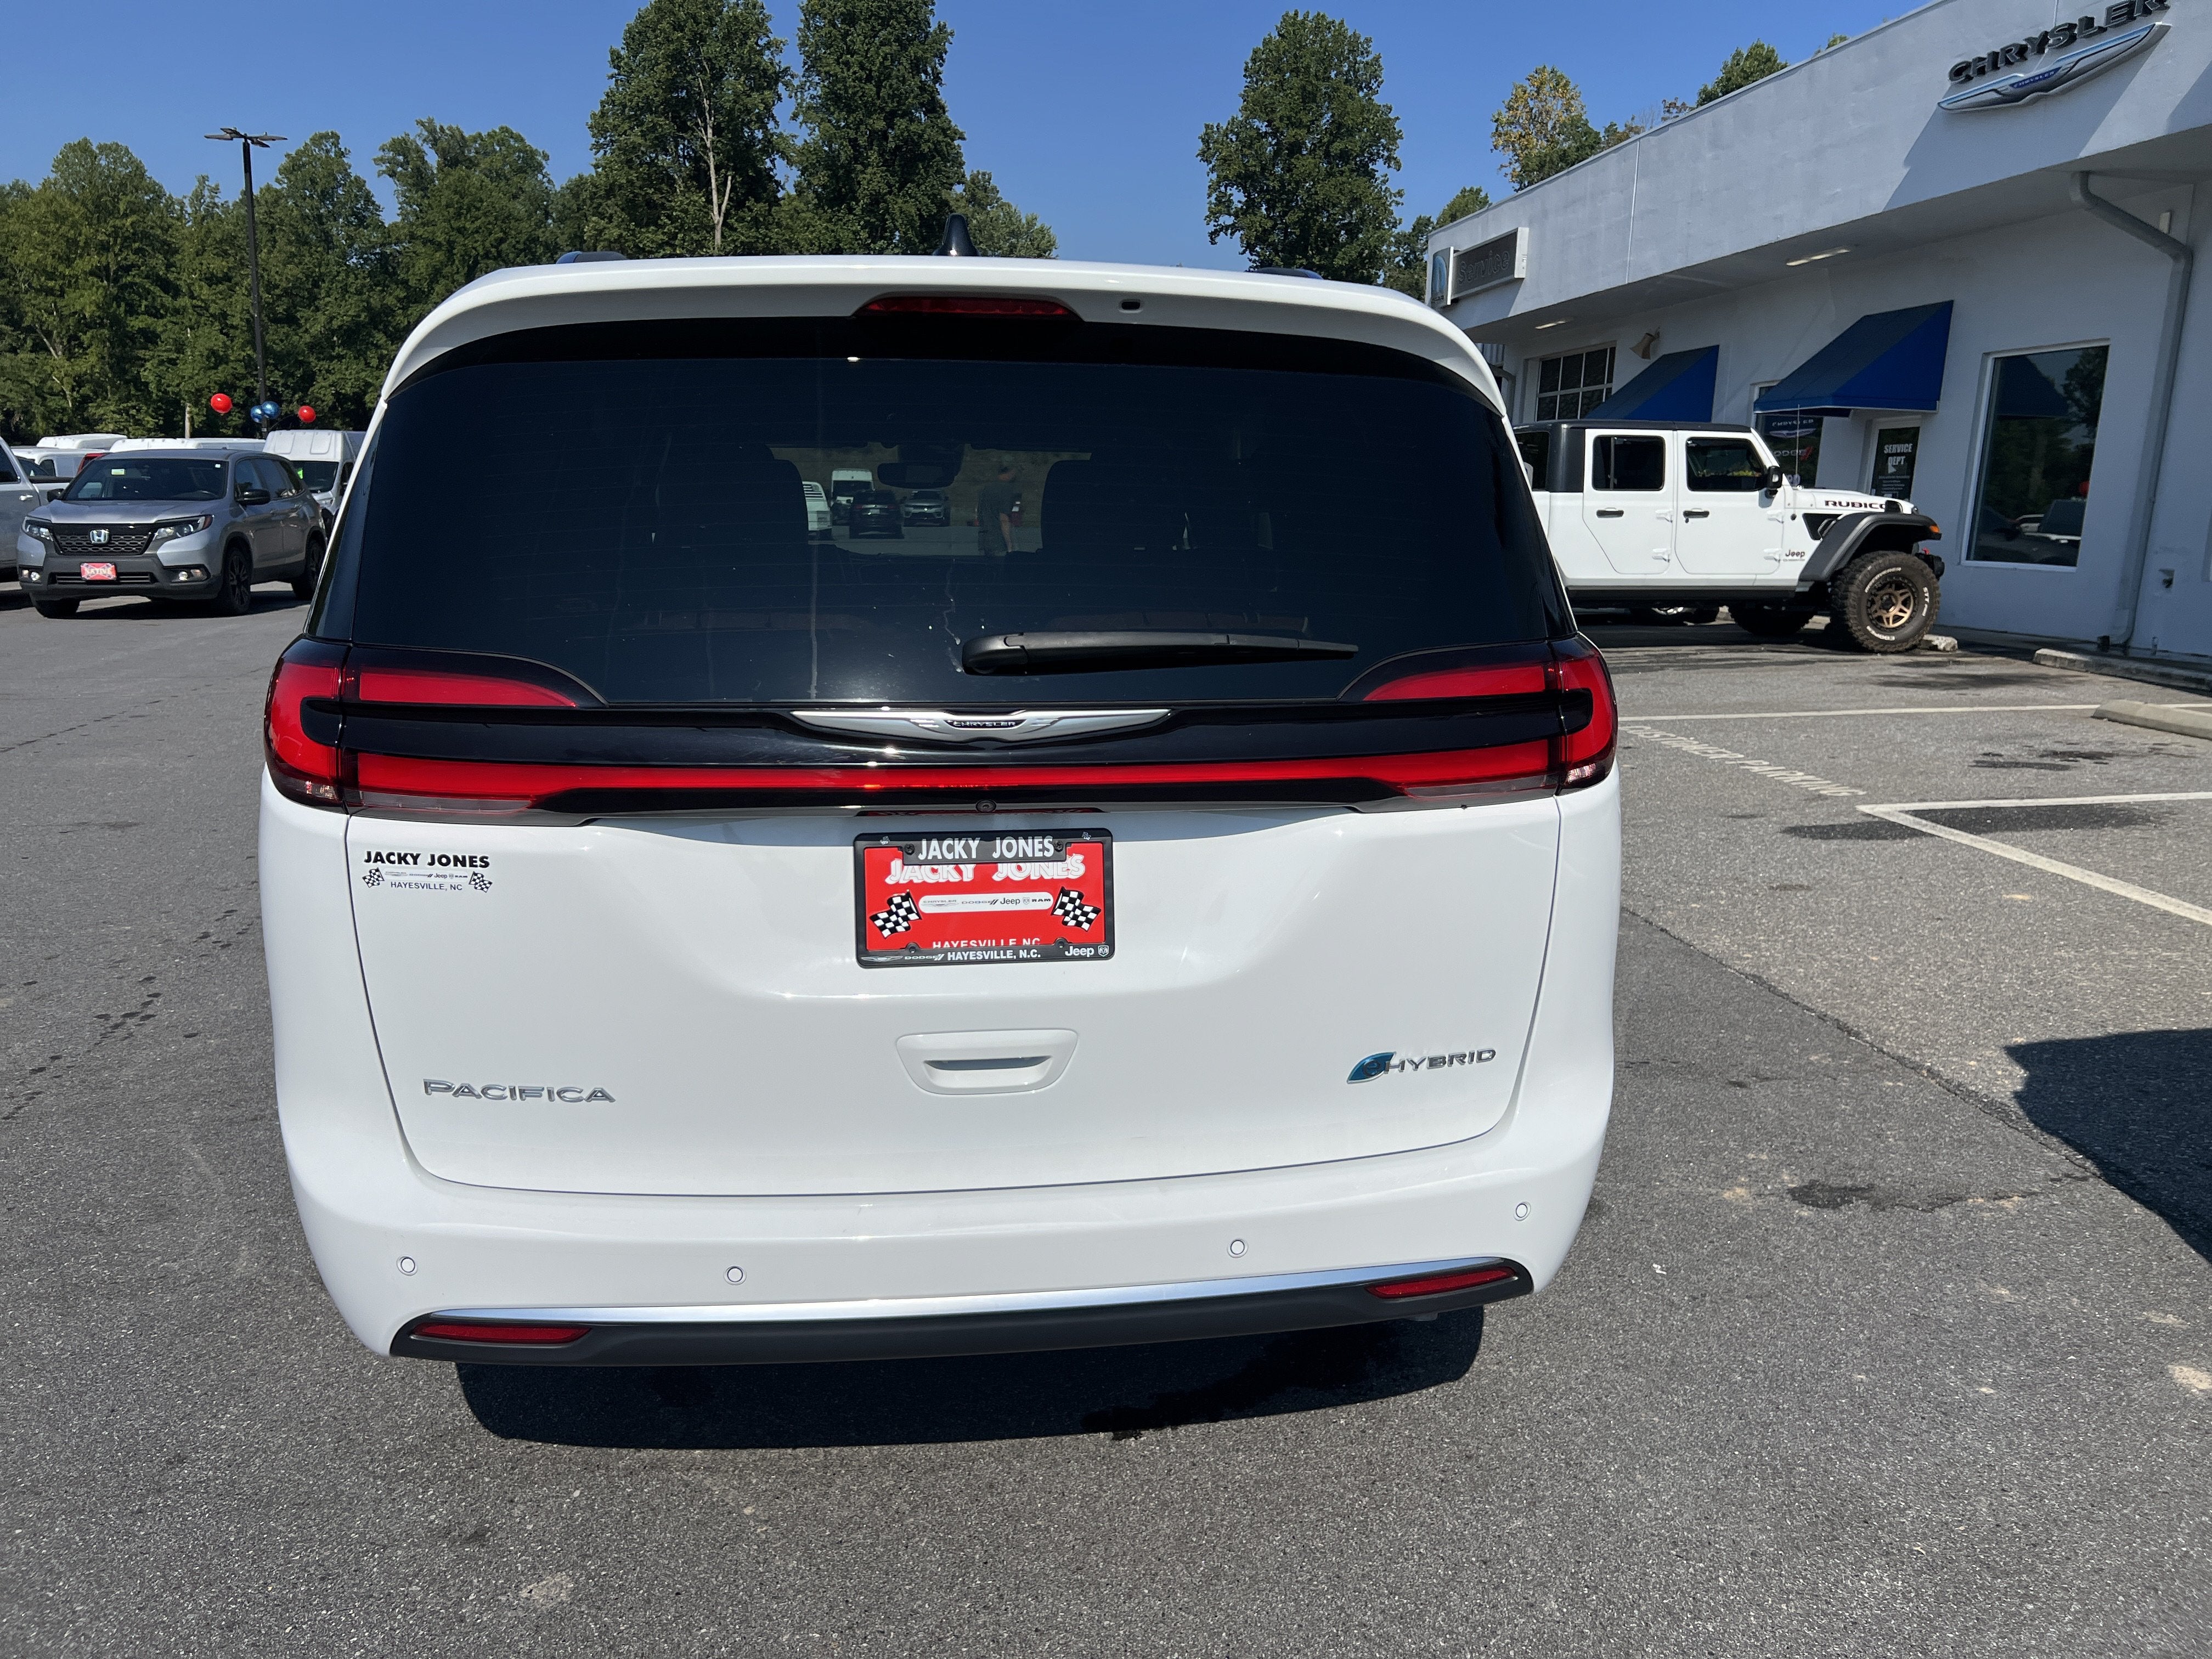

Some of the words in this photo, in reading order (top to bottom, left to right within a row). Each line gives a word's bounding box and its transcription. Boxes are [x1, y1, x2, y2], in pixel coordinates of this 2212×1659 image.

[1948, 0, 2171, 84] CHRYSLER
[1458, 250, 1509, 285] Service
[1883, 443, 1913, 454] SERVICE
[1888, 455, 1906, 466] DEPT
[1824, 500, 1886, 509] RUBICO
[1785, 549, 1805, 558] Jeep
[918, 837, 981, 860] JACKY
[992, 835, 1054, 859] JONES
[363, 850, 421, 865] JACKY
[427, 854, 490, 868] JONES
[885, 858, 977, 884] JACKY
[991, 853, 1086, 882] JONES
[391, 881, 447, 891] HAYESVILLE,
[947, 950, 1017, 961] HAYESVILLE,
[1019, 949, 1041, 958] N.C.
[1065, 946, 1094, 957] Jeep
[423, 1078, 616, 1103] PACIFICA
